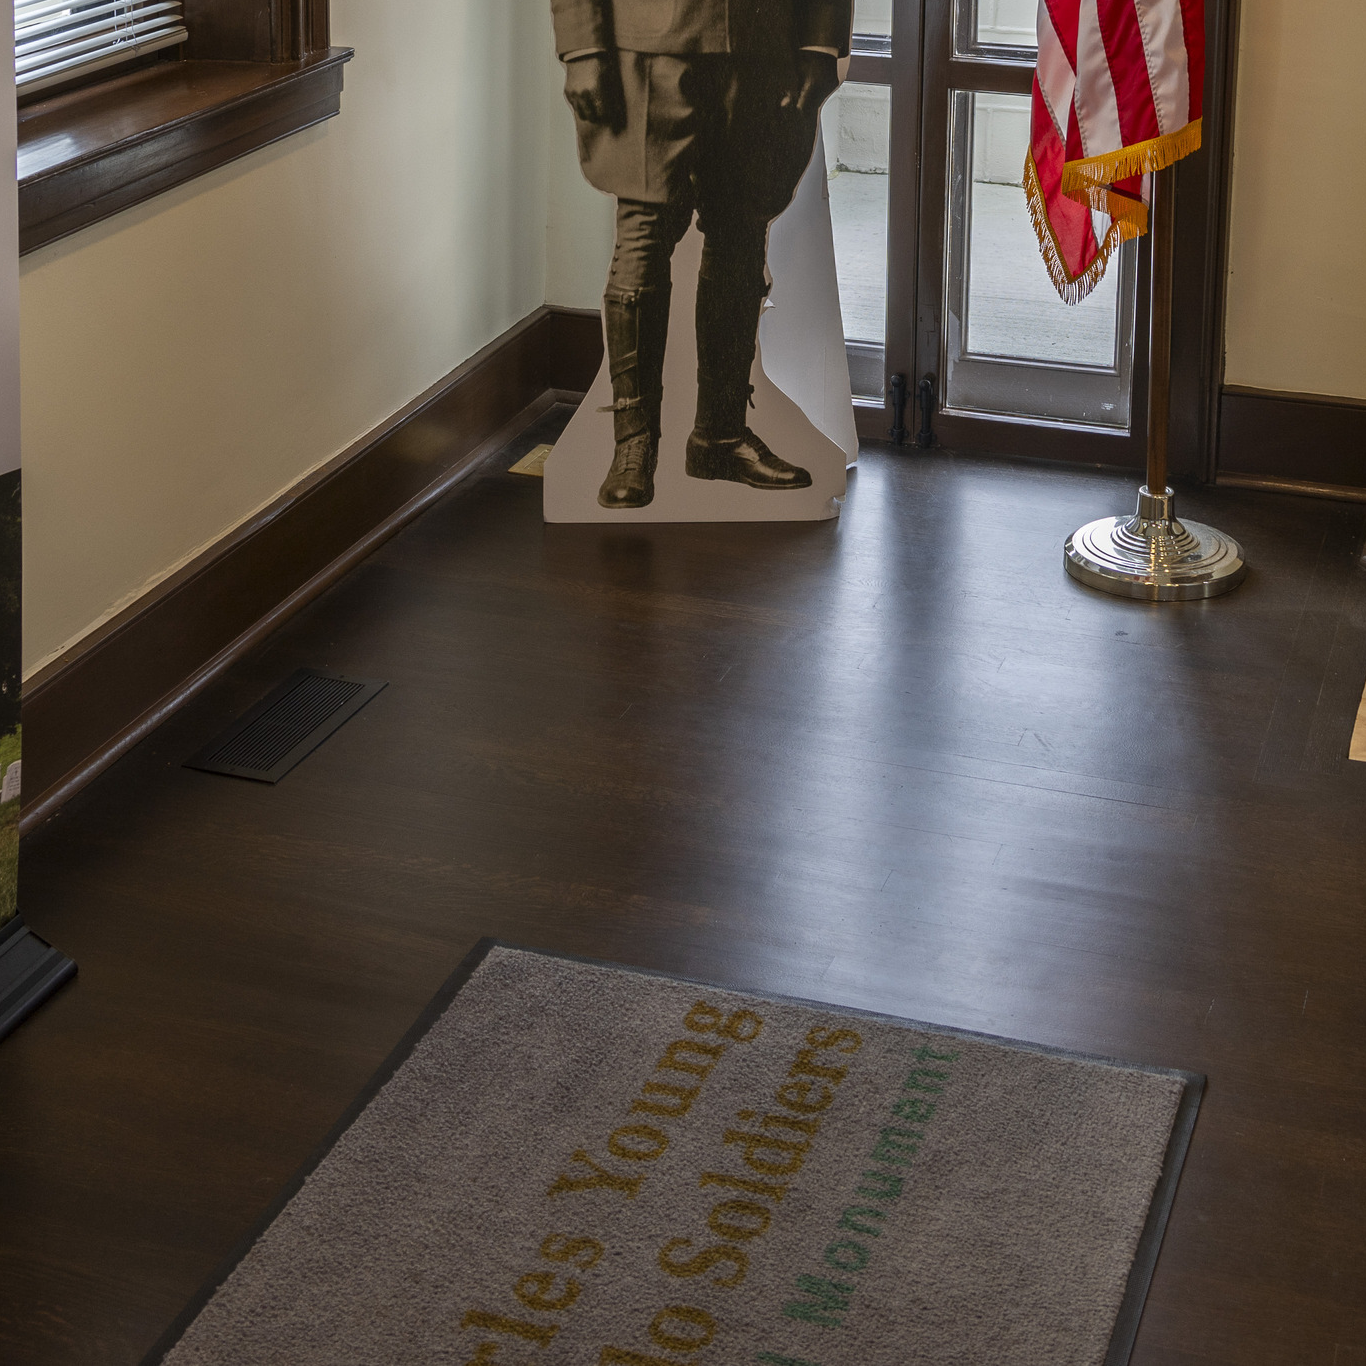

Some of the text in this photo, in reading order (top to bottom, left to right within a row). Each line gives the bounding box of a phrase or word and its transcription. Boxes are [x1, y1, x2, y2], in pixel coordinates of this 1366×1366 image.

[546, 1000, 764, 1200] Young
[658, 1026, 863, 1289] Soldiers
[781, 1046, 961, 1328] Monument
